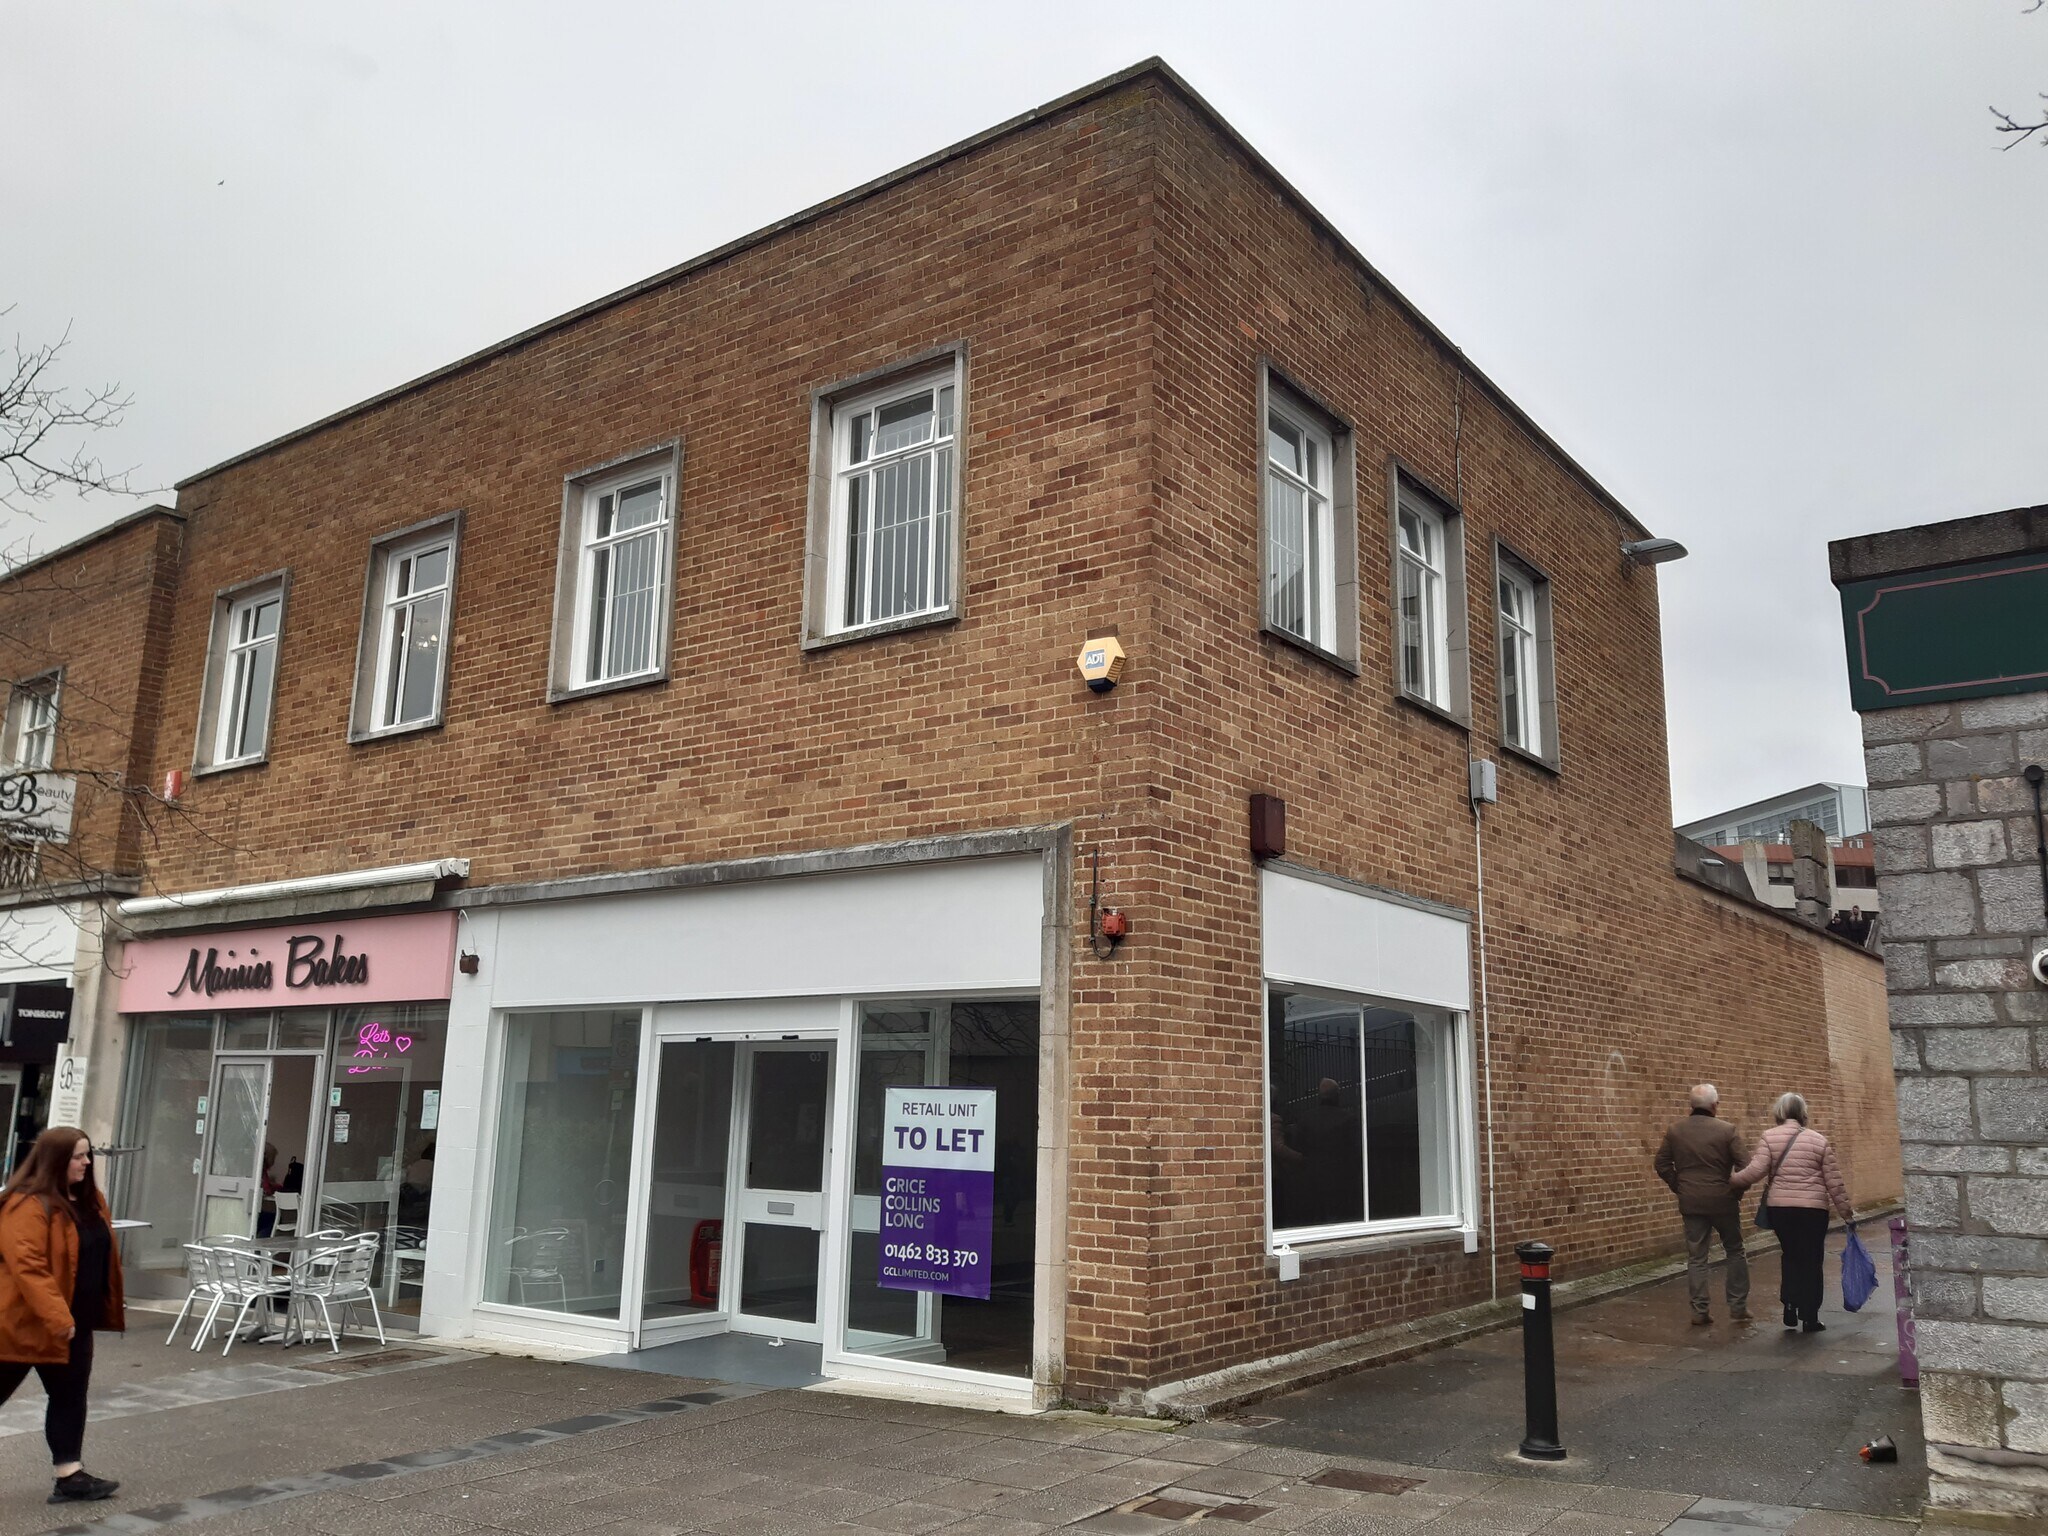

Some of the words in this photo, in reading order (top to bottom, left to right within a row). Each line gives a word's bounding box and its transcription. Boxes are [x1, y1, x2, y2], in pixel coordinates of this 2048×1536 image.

[1086, 652, 1105, 666] ADT
[286, 934, 369, 989] Bakes
[18, 1008, 66, 1019] TONI&GUY
[902, 1102, 944, 1117] RETAIL
[948, 1103, 978, 1118] UNIT
[894, 1126, 927, 1150] TO
[935, 1127, 985, 1153] LET
[885, 1177, 927, 1195] GRICE
[885, 1194, 941, 1213] COLLINS
[885, 1213, 924, 1229] LONG
[884, 1243, 923, 1262] 01462
[925, 1244, 950, 1266] 833
[953, 1250, 979, 1268] 370
[883, 1267, 949, 1281] GCLLIMITED.COM
